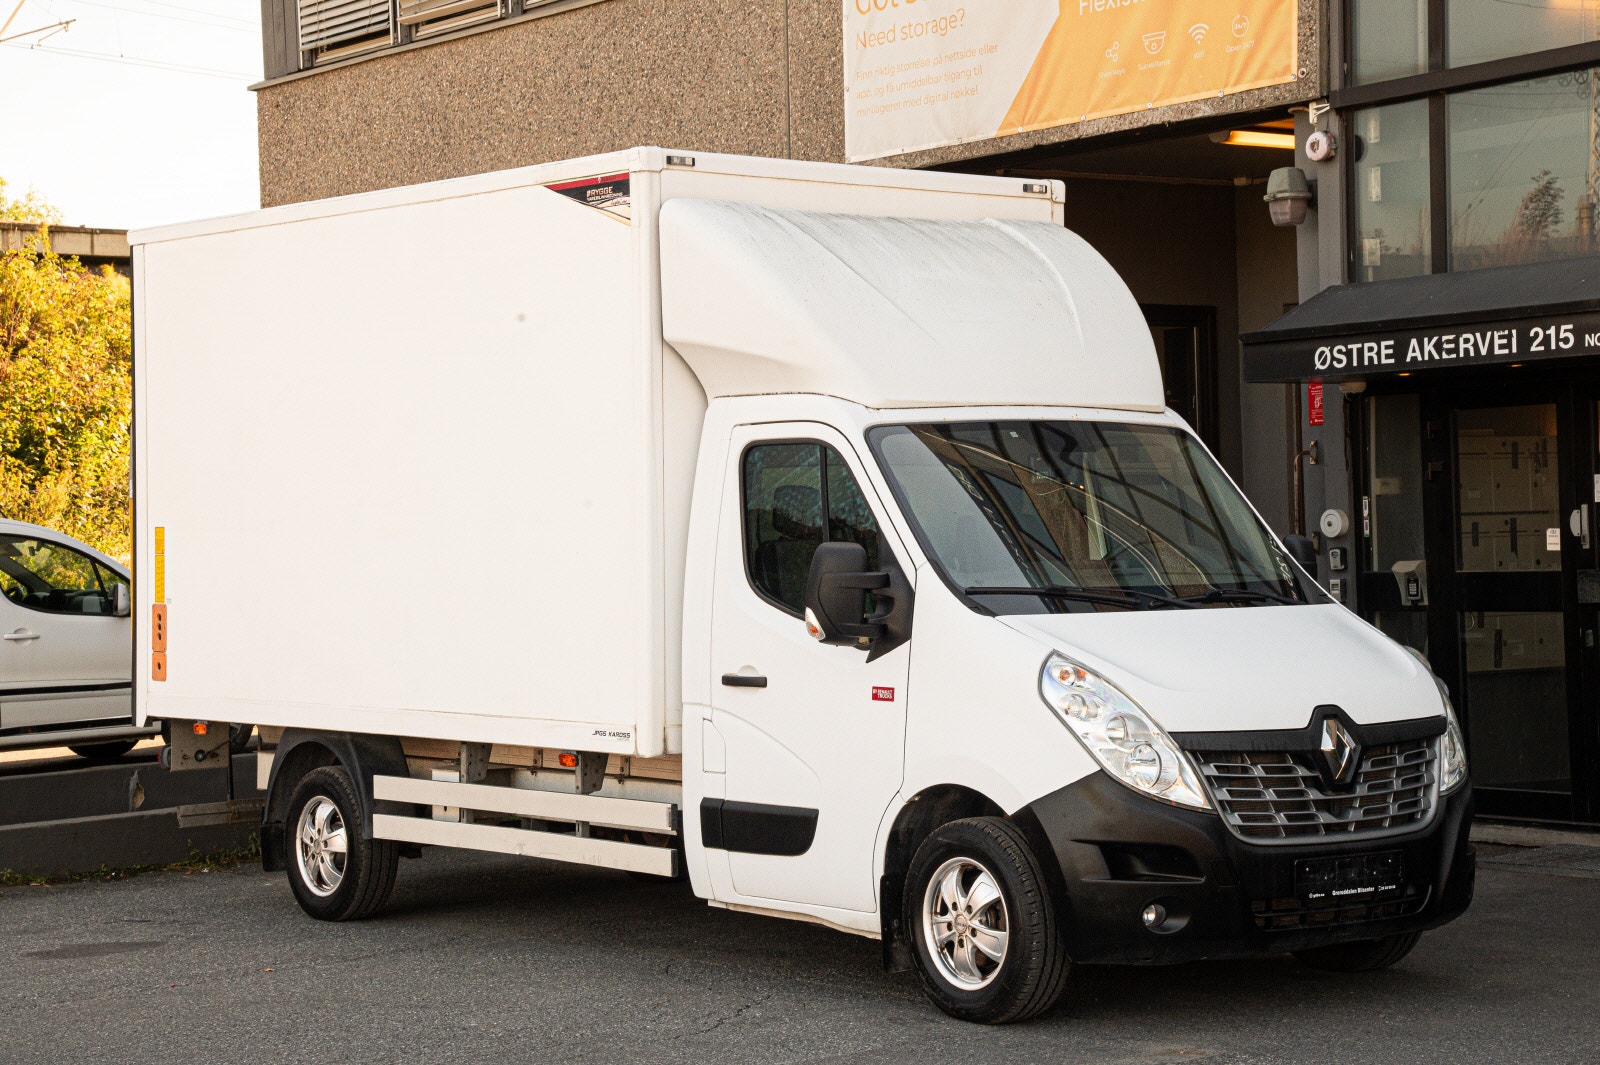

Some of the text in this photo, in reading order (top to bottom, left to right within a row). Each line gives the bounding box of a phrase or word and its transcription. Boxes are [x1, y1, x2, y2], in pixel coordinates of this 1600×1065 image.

[855, 8, 965, 49] Need storage?
[856, 70, 873, 81] Finn
[875, 65, 895, 77] riktig
[944, 48, 977, 62] nettside
[978, 43, 998, 55] eller
[874, 87, 884, 97] og
[895, 75, 942, 91] umiddelbar
[943, 69, 972, 83] tilgang
[973, 64, 983, 76] til
[856, 102, 901, 117] minilageret
[903, 96, 922, 108] med
[923, 91, 949, 106] digital
[1314, 340, 1395, 370] ØSTRE
[1405, 329, 1517, 362] AKERVEI
[1529, 324, 1575, 352] 215
